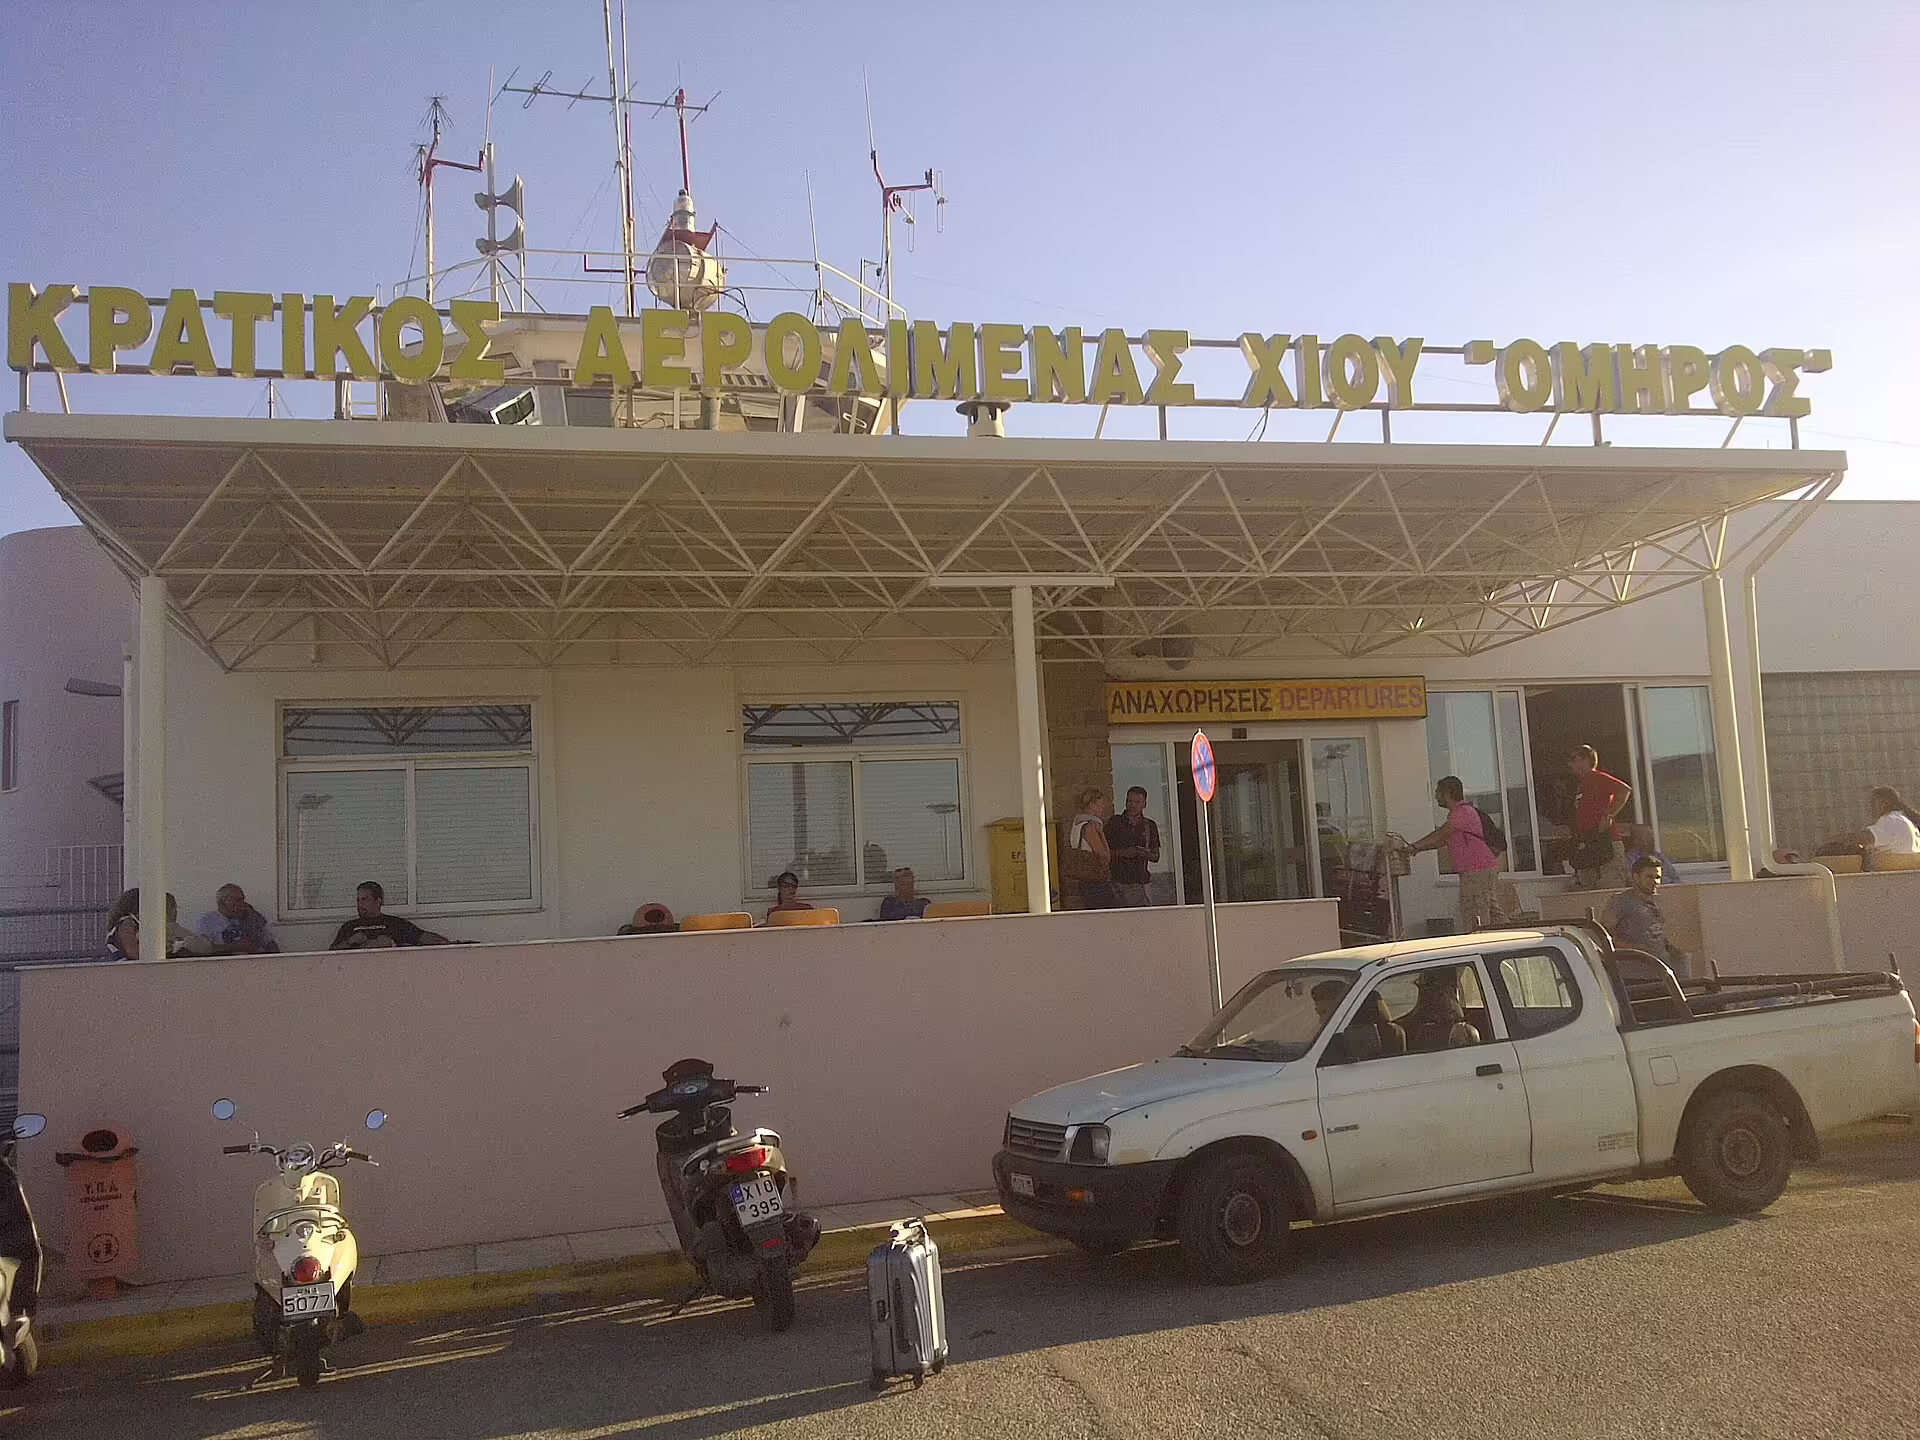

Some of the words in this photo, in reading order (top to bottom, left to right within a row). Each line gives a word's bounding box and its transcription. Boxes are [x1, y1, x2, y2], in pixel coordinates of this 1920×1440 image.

[8, 283, 504, 383] ΚΡΑΤΙΚΟΣ
[575, 306, 1196, 405] ΑΕΡΟΛΙΜΕΝΑΣ
[1238, 333, 1424, 410] ΧΙΟΥ
[1110, 688, 1273, 715] ΑΝΑΧΩΡΗΣΕΙΣ
[1279, 684, 1424, 711] DEPARTURES
[749, 1197, 780, 1218] 395
[285, 1294, 330, 1312] 5077
